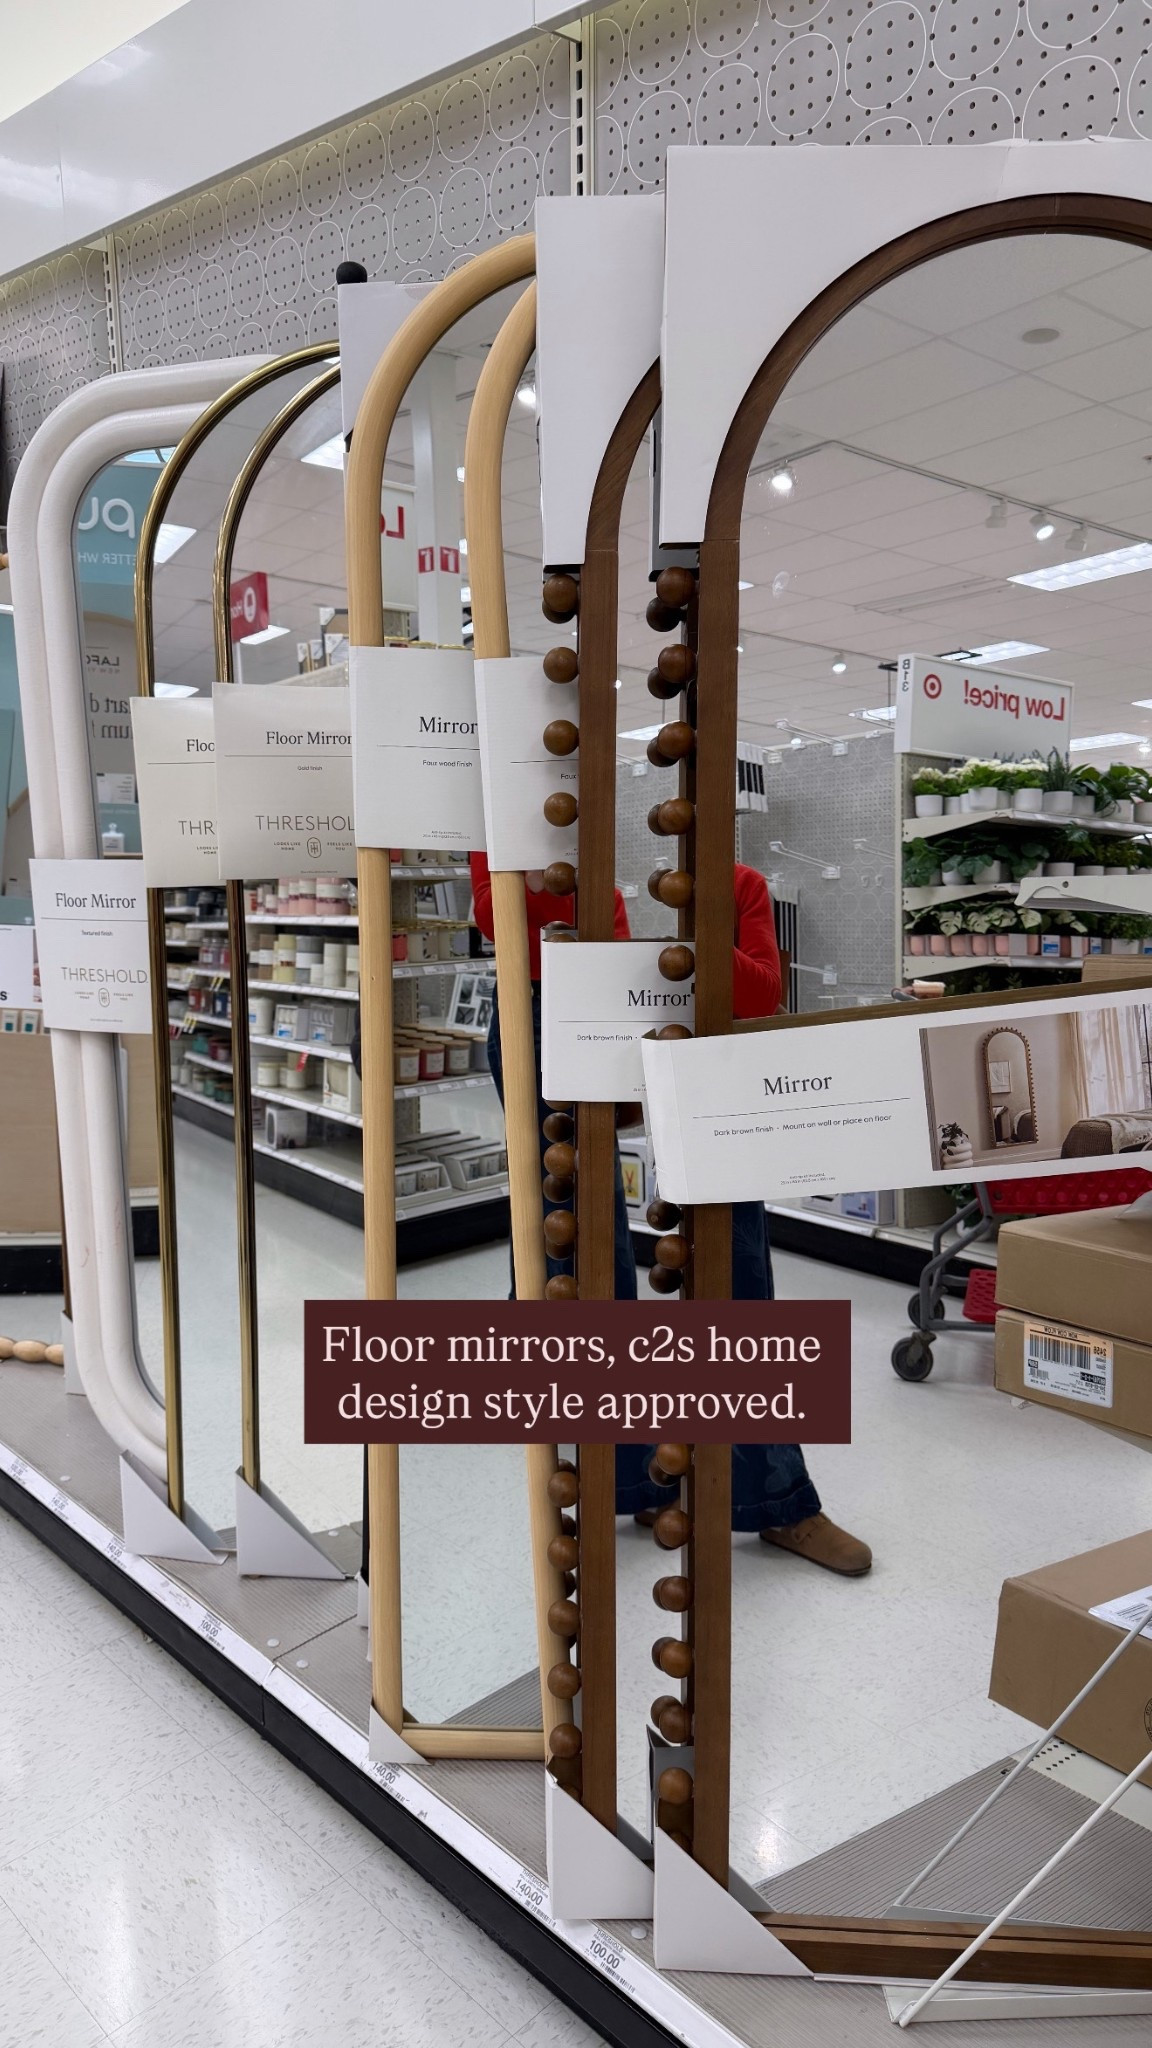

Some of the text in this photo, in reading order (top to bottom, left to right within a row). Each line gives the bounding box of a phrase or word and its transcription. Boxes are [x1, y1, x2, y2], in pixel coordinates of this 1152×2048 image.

[419, 716, 478, 734] Mirror
[266, 731, 352, 745] Floor Mirror
[456, 760, 473, 768] finish
[55, 892, 137, 909] Floor Mirror
[627, 989, 691, 1007] Mirror
[763, 1075, 833, 1096] Mirror
[714, 1129, 730, 1137] Dark
[731, 1127, 754, 1136] brown
[755, 1125, 774, 1133] finish
[782, 1122, 806, 1131] Mount
[817, 1119, 832, 1127] wall
[842, 1117, 863, 1126] place
[874, 1114, 892, 1122] floor
[200, 1619, 219, 1638] 100.00
[372, 1761, 397, 1785] 140.00
[515, 1878, 543, 1906] 140.00
[589, 1938, 620, 1969] 100.00
